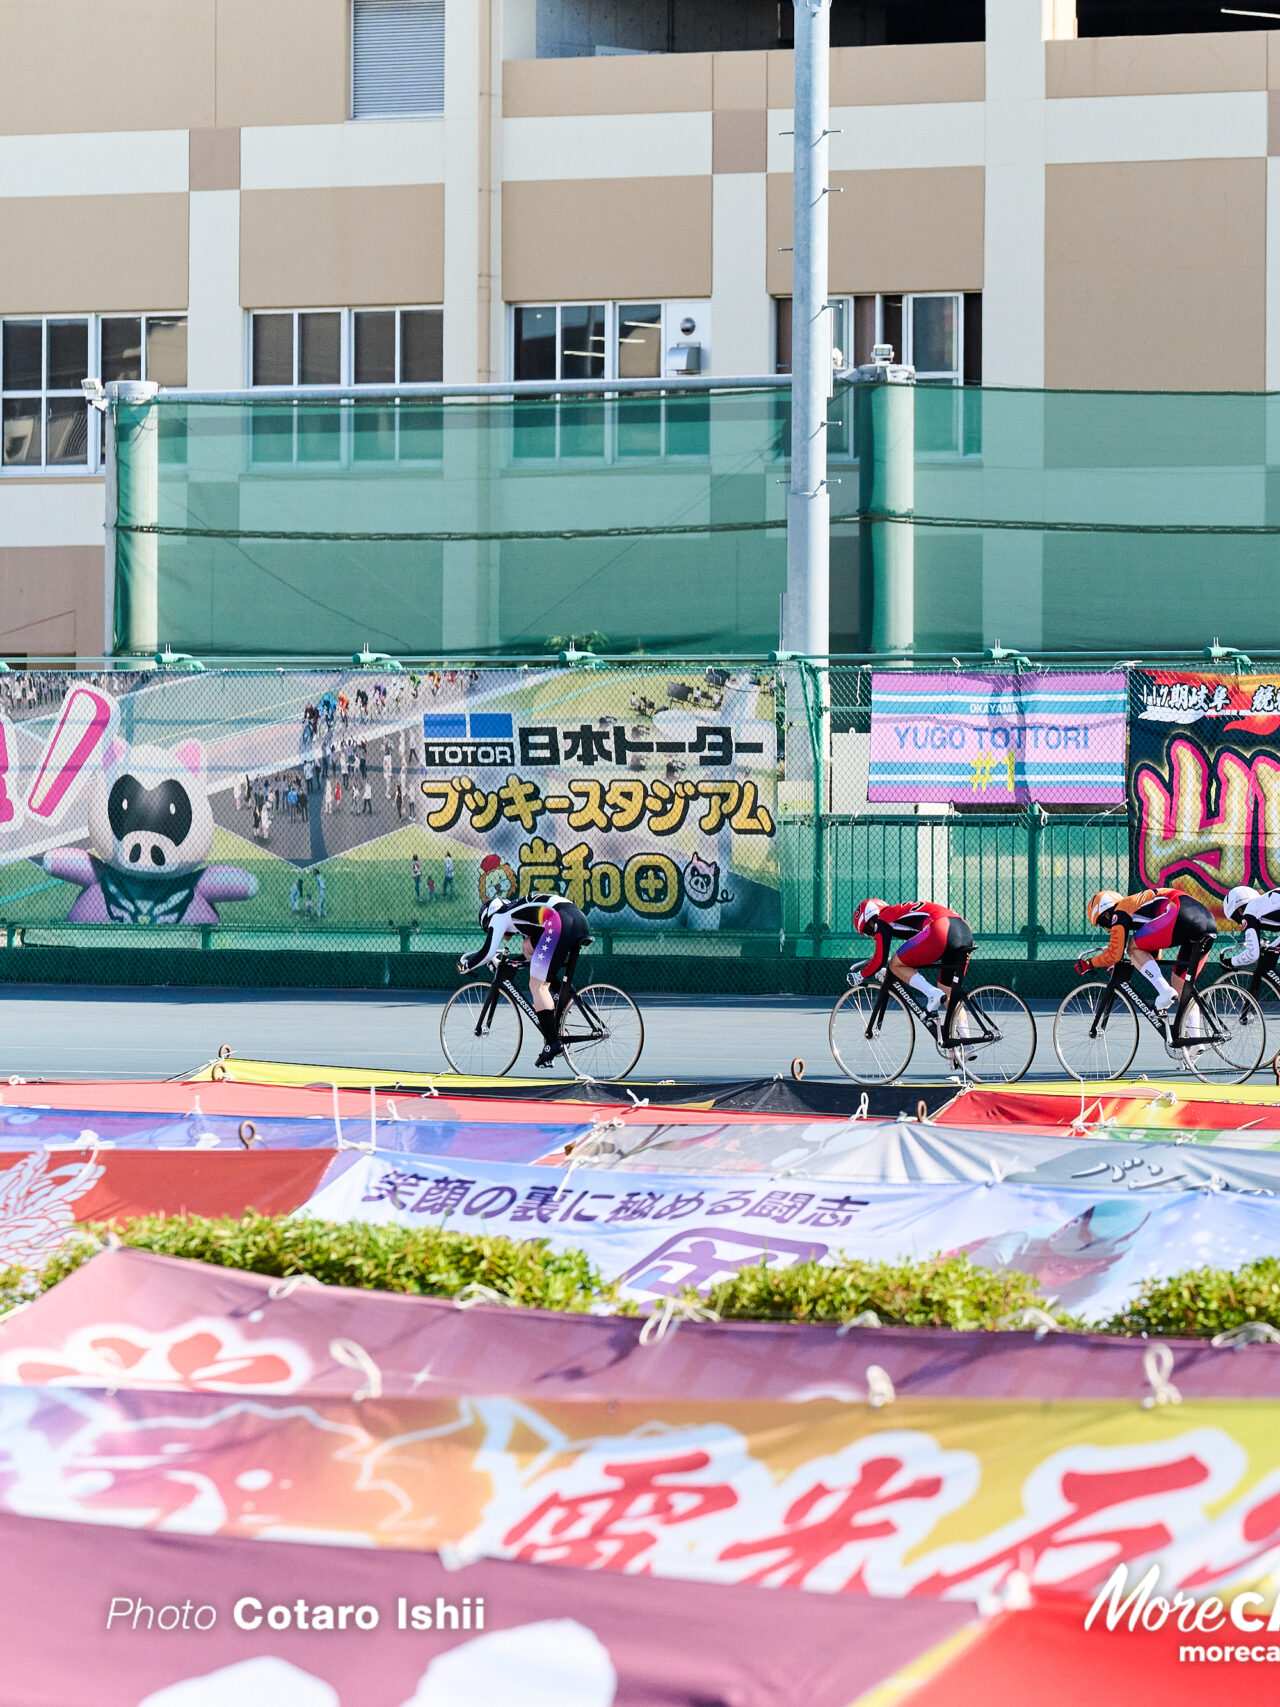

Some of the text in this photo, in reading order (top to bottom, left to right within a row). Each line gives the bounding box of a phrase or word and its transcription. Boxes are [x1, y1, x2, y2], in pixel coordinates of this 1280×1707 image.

[969, 703, 1018, 714] OKAYAMA
[427, 745, 513, 765] TOTOR
[518, 725, 764, 766] 日本トーター
[894, 726, 1090, 750] YUGO TOTTORI
[968, 750, 1016, 793] #1
[421, 774, 776, 837] ブッキースタジアム
[519, 837, 680, 919] 岸和田
[361, 1168, 871, 1229] 笑顔の裏に秘める闘志
